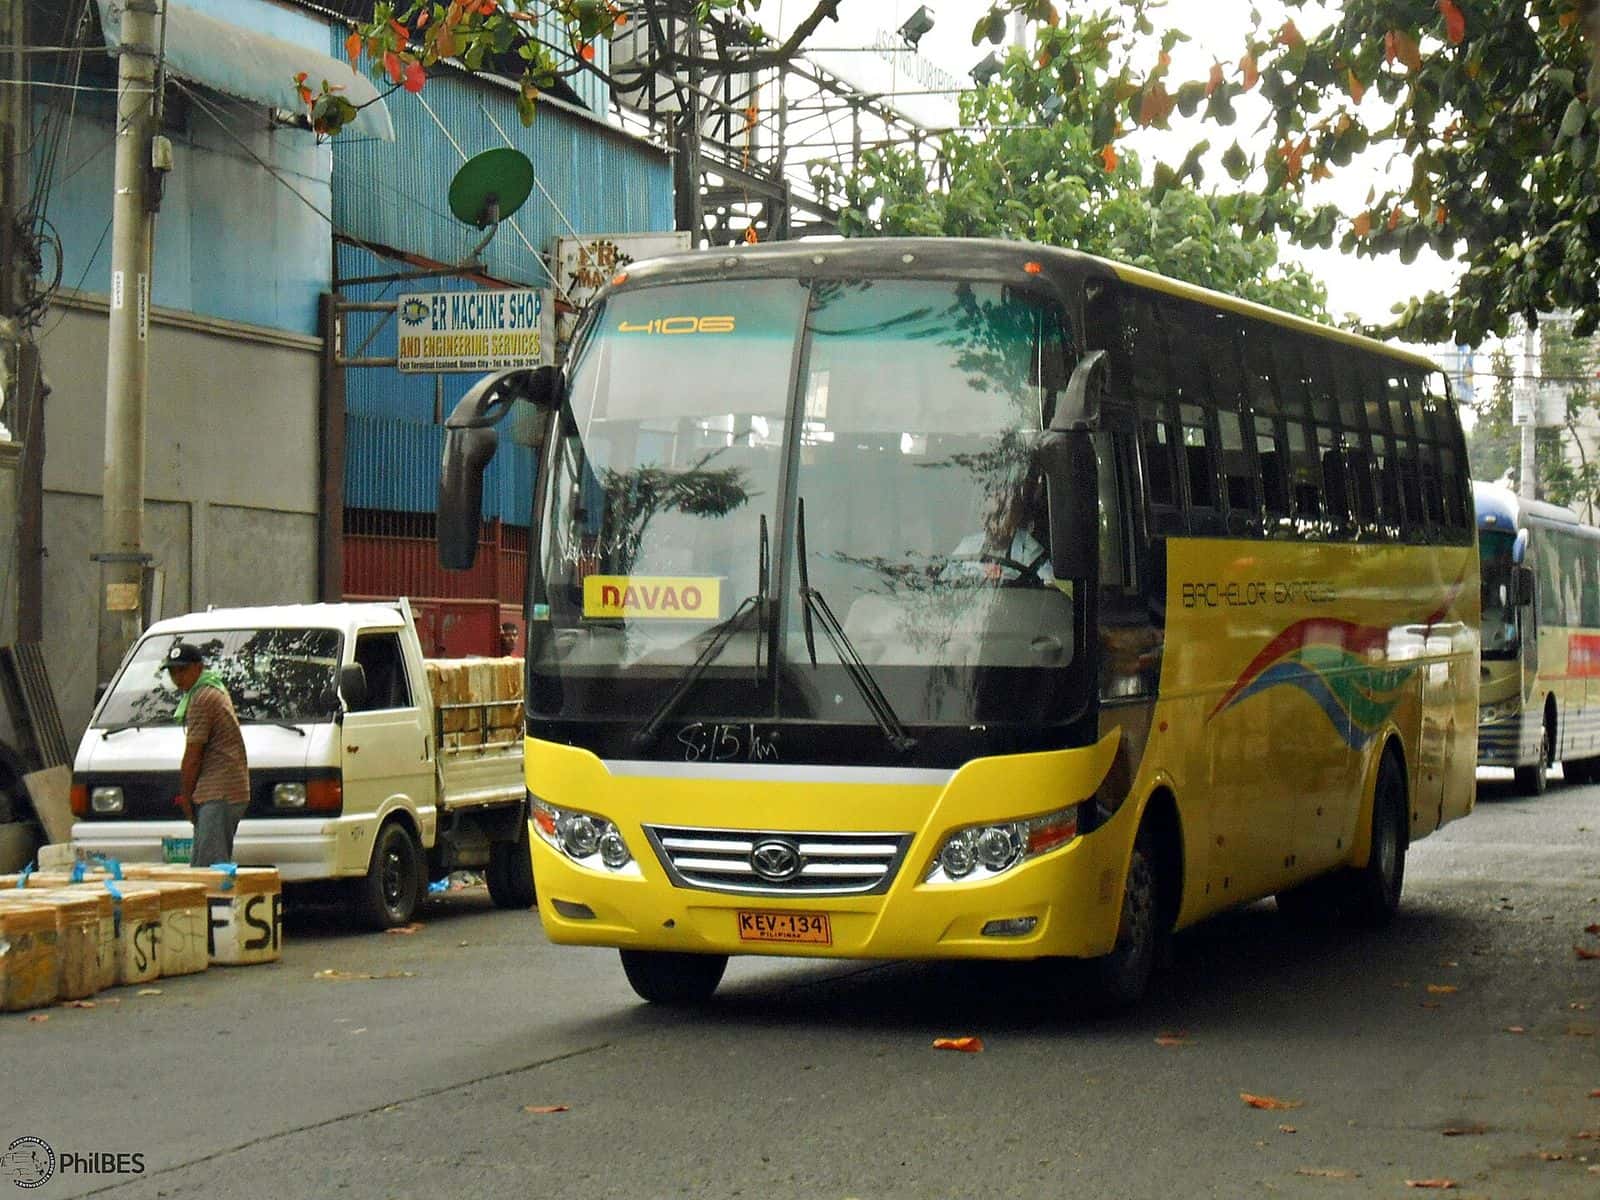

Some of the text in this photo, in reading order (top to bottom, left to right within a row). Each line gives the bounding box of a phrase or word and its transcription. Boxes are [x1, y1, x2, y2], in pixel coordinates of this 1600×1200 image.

[431, 293, 541, 330] ER MACHINE SHOP
[400, 333, 540, 358] AND ENGINEERING SERVICES
[602, 585, 702, 610] DAVAO
[1182, 581, 1336, 608] BACHELOR EXPRESS
